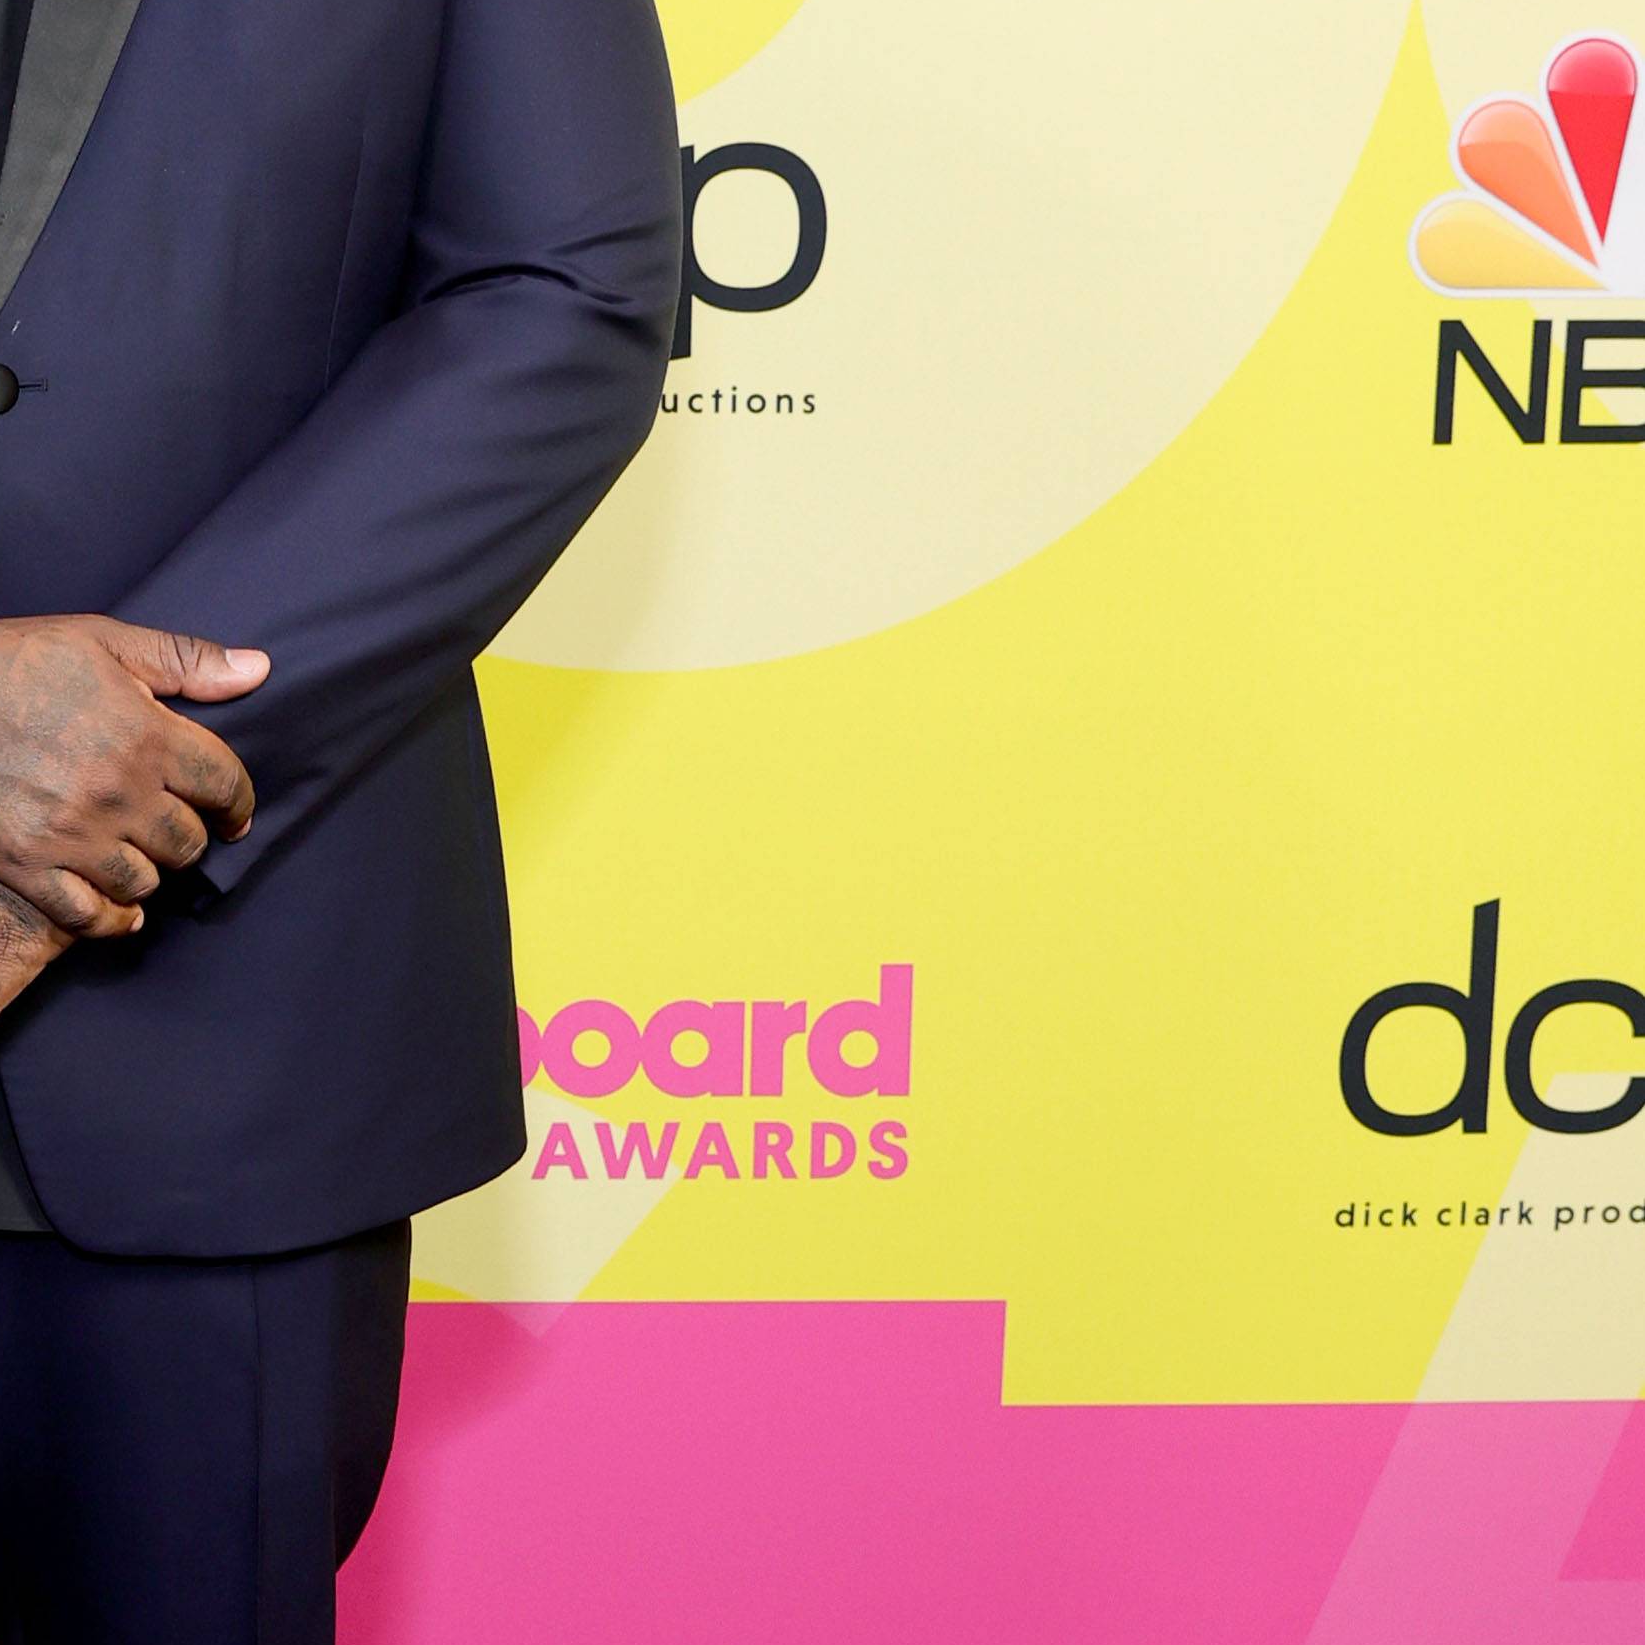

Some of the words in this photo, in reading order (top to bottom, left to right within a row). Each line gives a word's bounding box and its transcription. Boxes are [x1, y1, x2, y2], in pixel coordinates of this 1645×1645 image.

[517, 964, 913, 1098] oard
[533, 1121, 909, 1180] AWARDS
[1336, 1204, 1417, 1228] dick
[1438, 1202, 1533, 1227] clark
